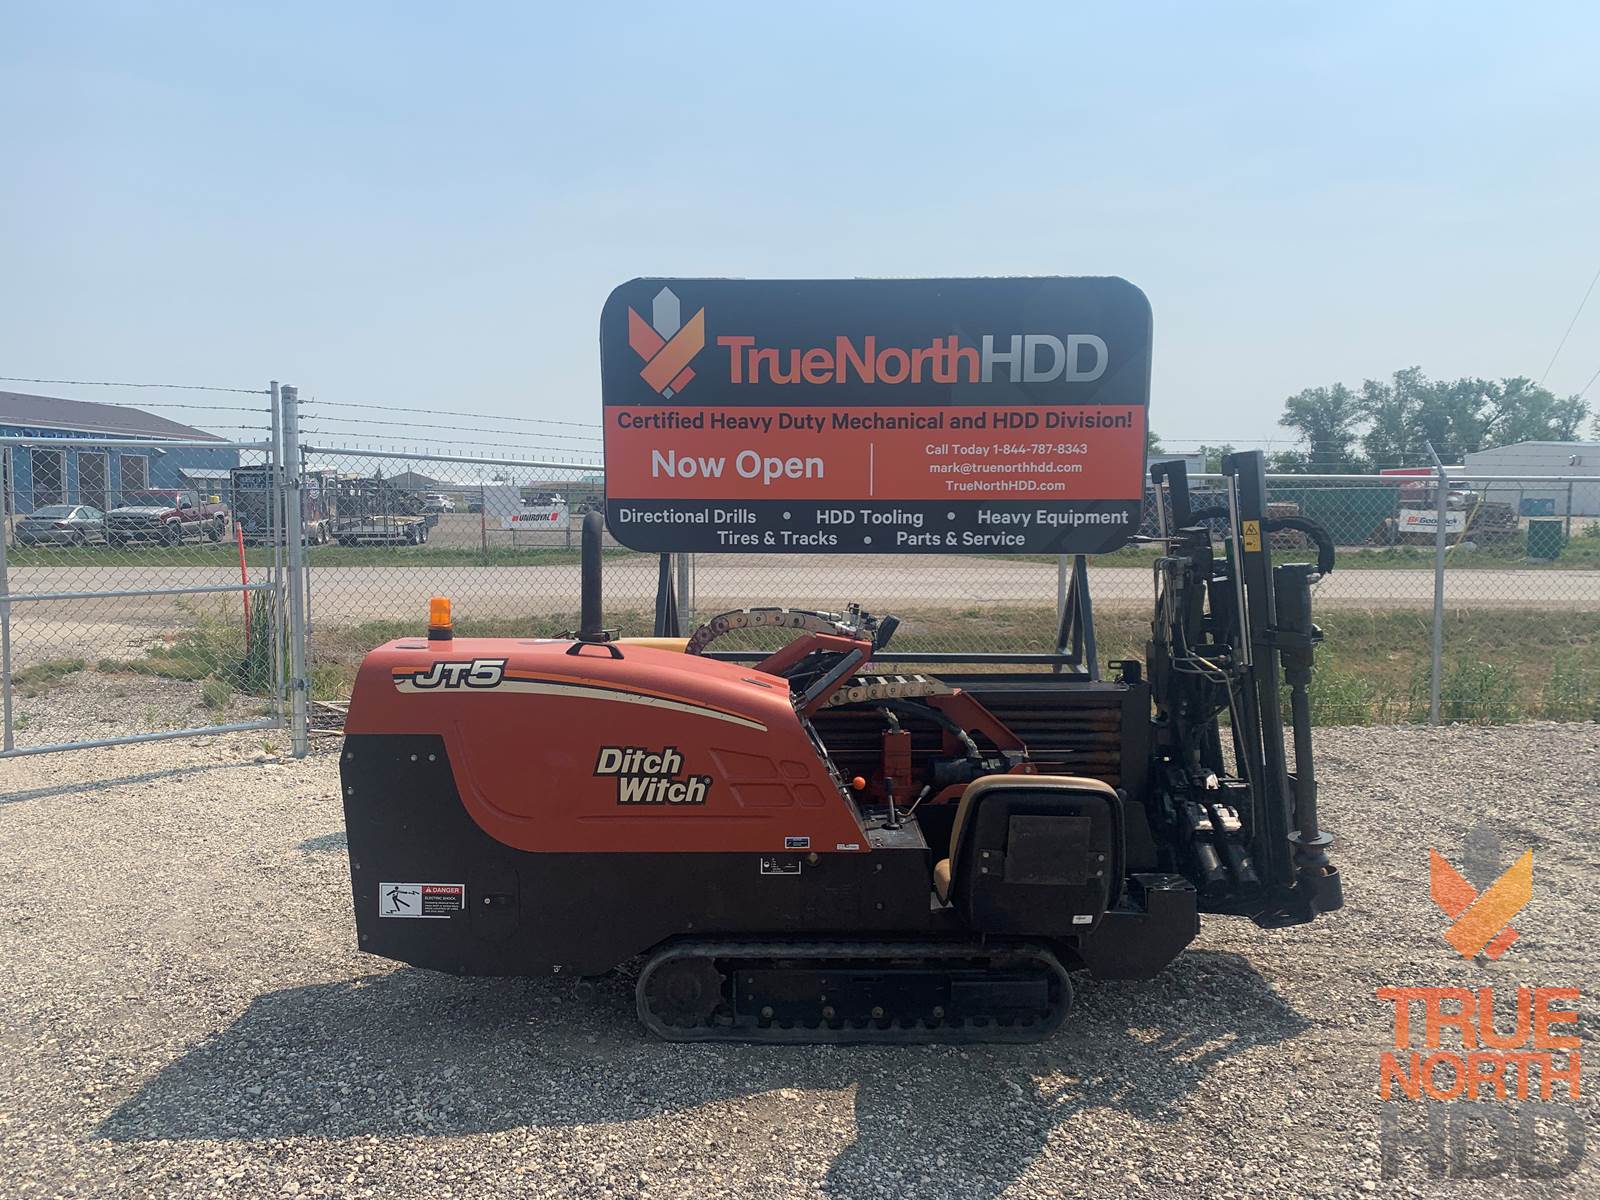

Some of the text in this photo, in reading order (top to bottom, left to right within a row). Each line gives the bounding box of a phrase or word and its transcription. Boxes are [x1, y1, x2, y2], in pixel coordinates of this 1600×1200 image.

[716, 333, 1109, 385] TrueNorthHDD
[617, 411, 1133, 433] Certified Heavy Duty Mechanical and HDD Division!
[925, 443, 1088, 457] Call Today 1-844-787-8343
[651, 450, 824, 485] Now Open
[929, 462, 1083, 475] mark@truenorthhdd.com
[945, 480, 1066, 492] TrueNorthHDD.com
[519, 513, 551, 522] UNIROYAL
[619, 508, 1129, 528] Directional Drills HDD Tooling Heavy Equipment
[717, 530, 1026, 547] Tires & Tracks Parts & Service
[414, 660, 506, 687] JT5
[596, 747, 682, 774] Ditch
[619, 777, 706, 803] Witch
